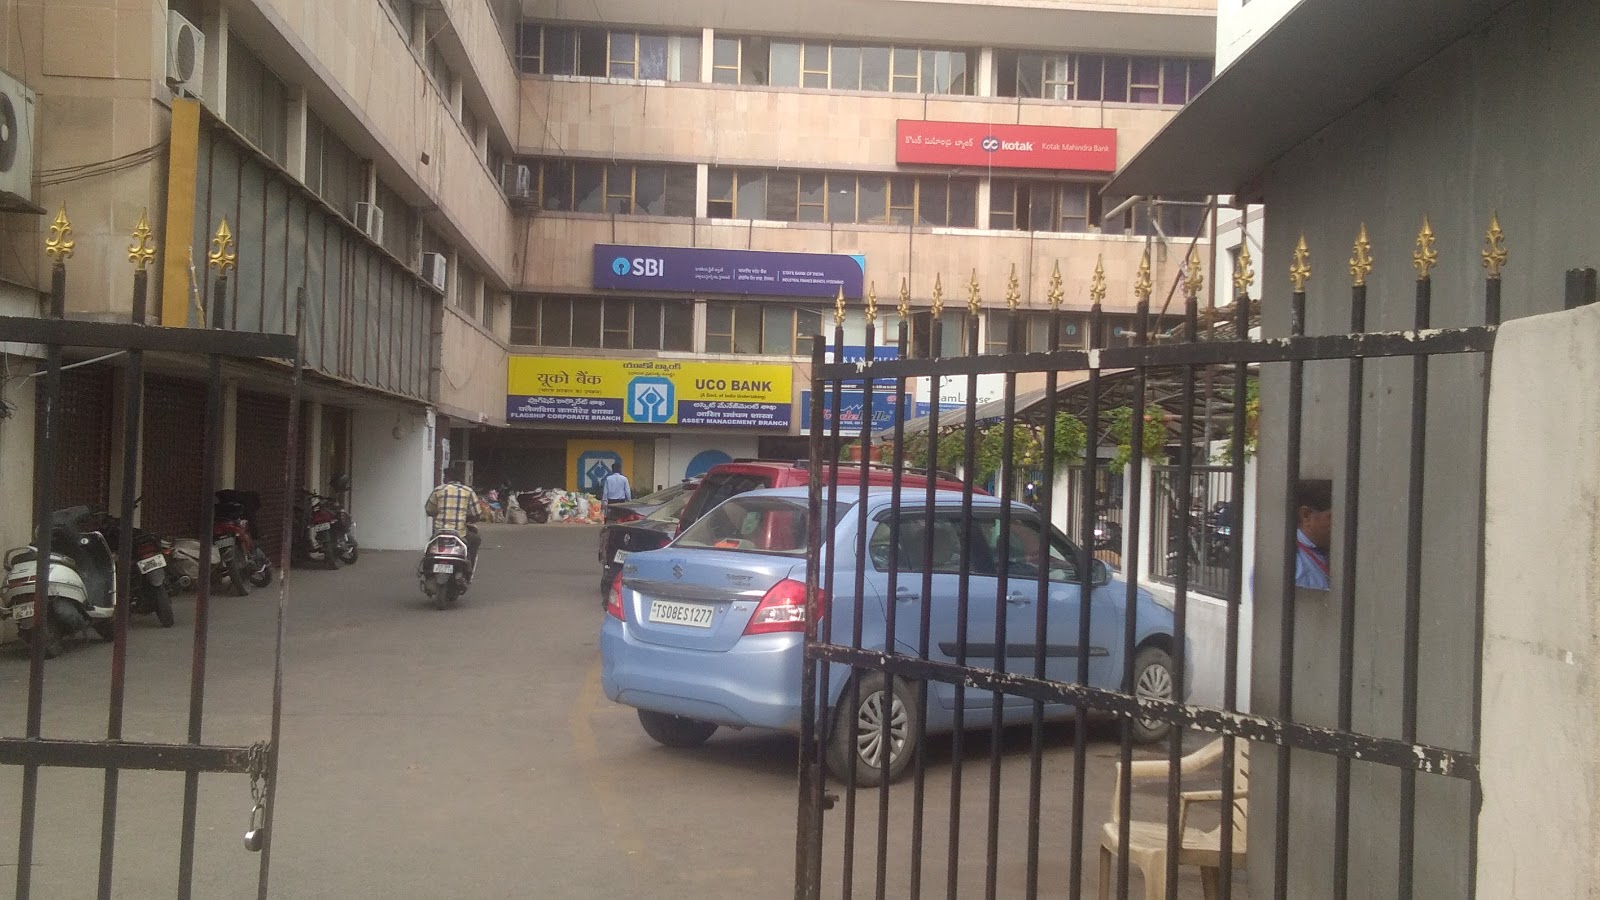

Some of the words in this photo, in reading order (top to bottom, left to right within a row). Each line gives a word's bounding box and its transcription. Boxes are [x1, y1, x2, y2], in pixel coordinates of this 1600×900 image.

[1001, 140, 1033, 151] kotak
[1041, 142, 1060, 151] Kotak
[1061, 143, 1092, 152] Mahindra
[1093, 144, 1110, 152] Bank
[632, 257, 664, 277] SBI
[537, 370, 569, 388] यूको
[576, 370, 602, 385] बैंक
[695, 378, 727, 391] UCO
[731, 380, 772, 392] BANK
[706, 418, 757, 426] MANAGEMENT
[656, 603, 713, 624] TS08ES1277
